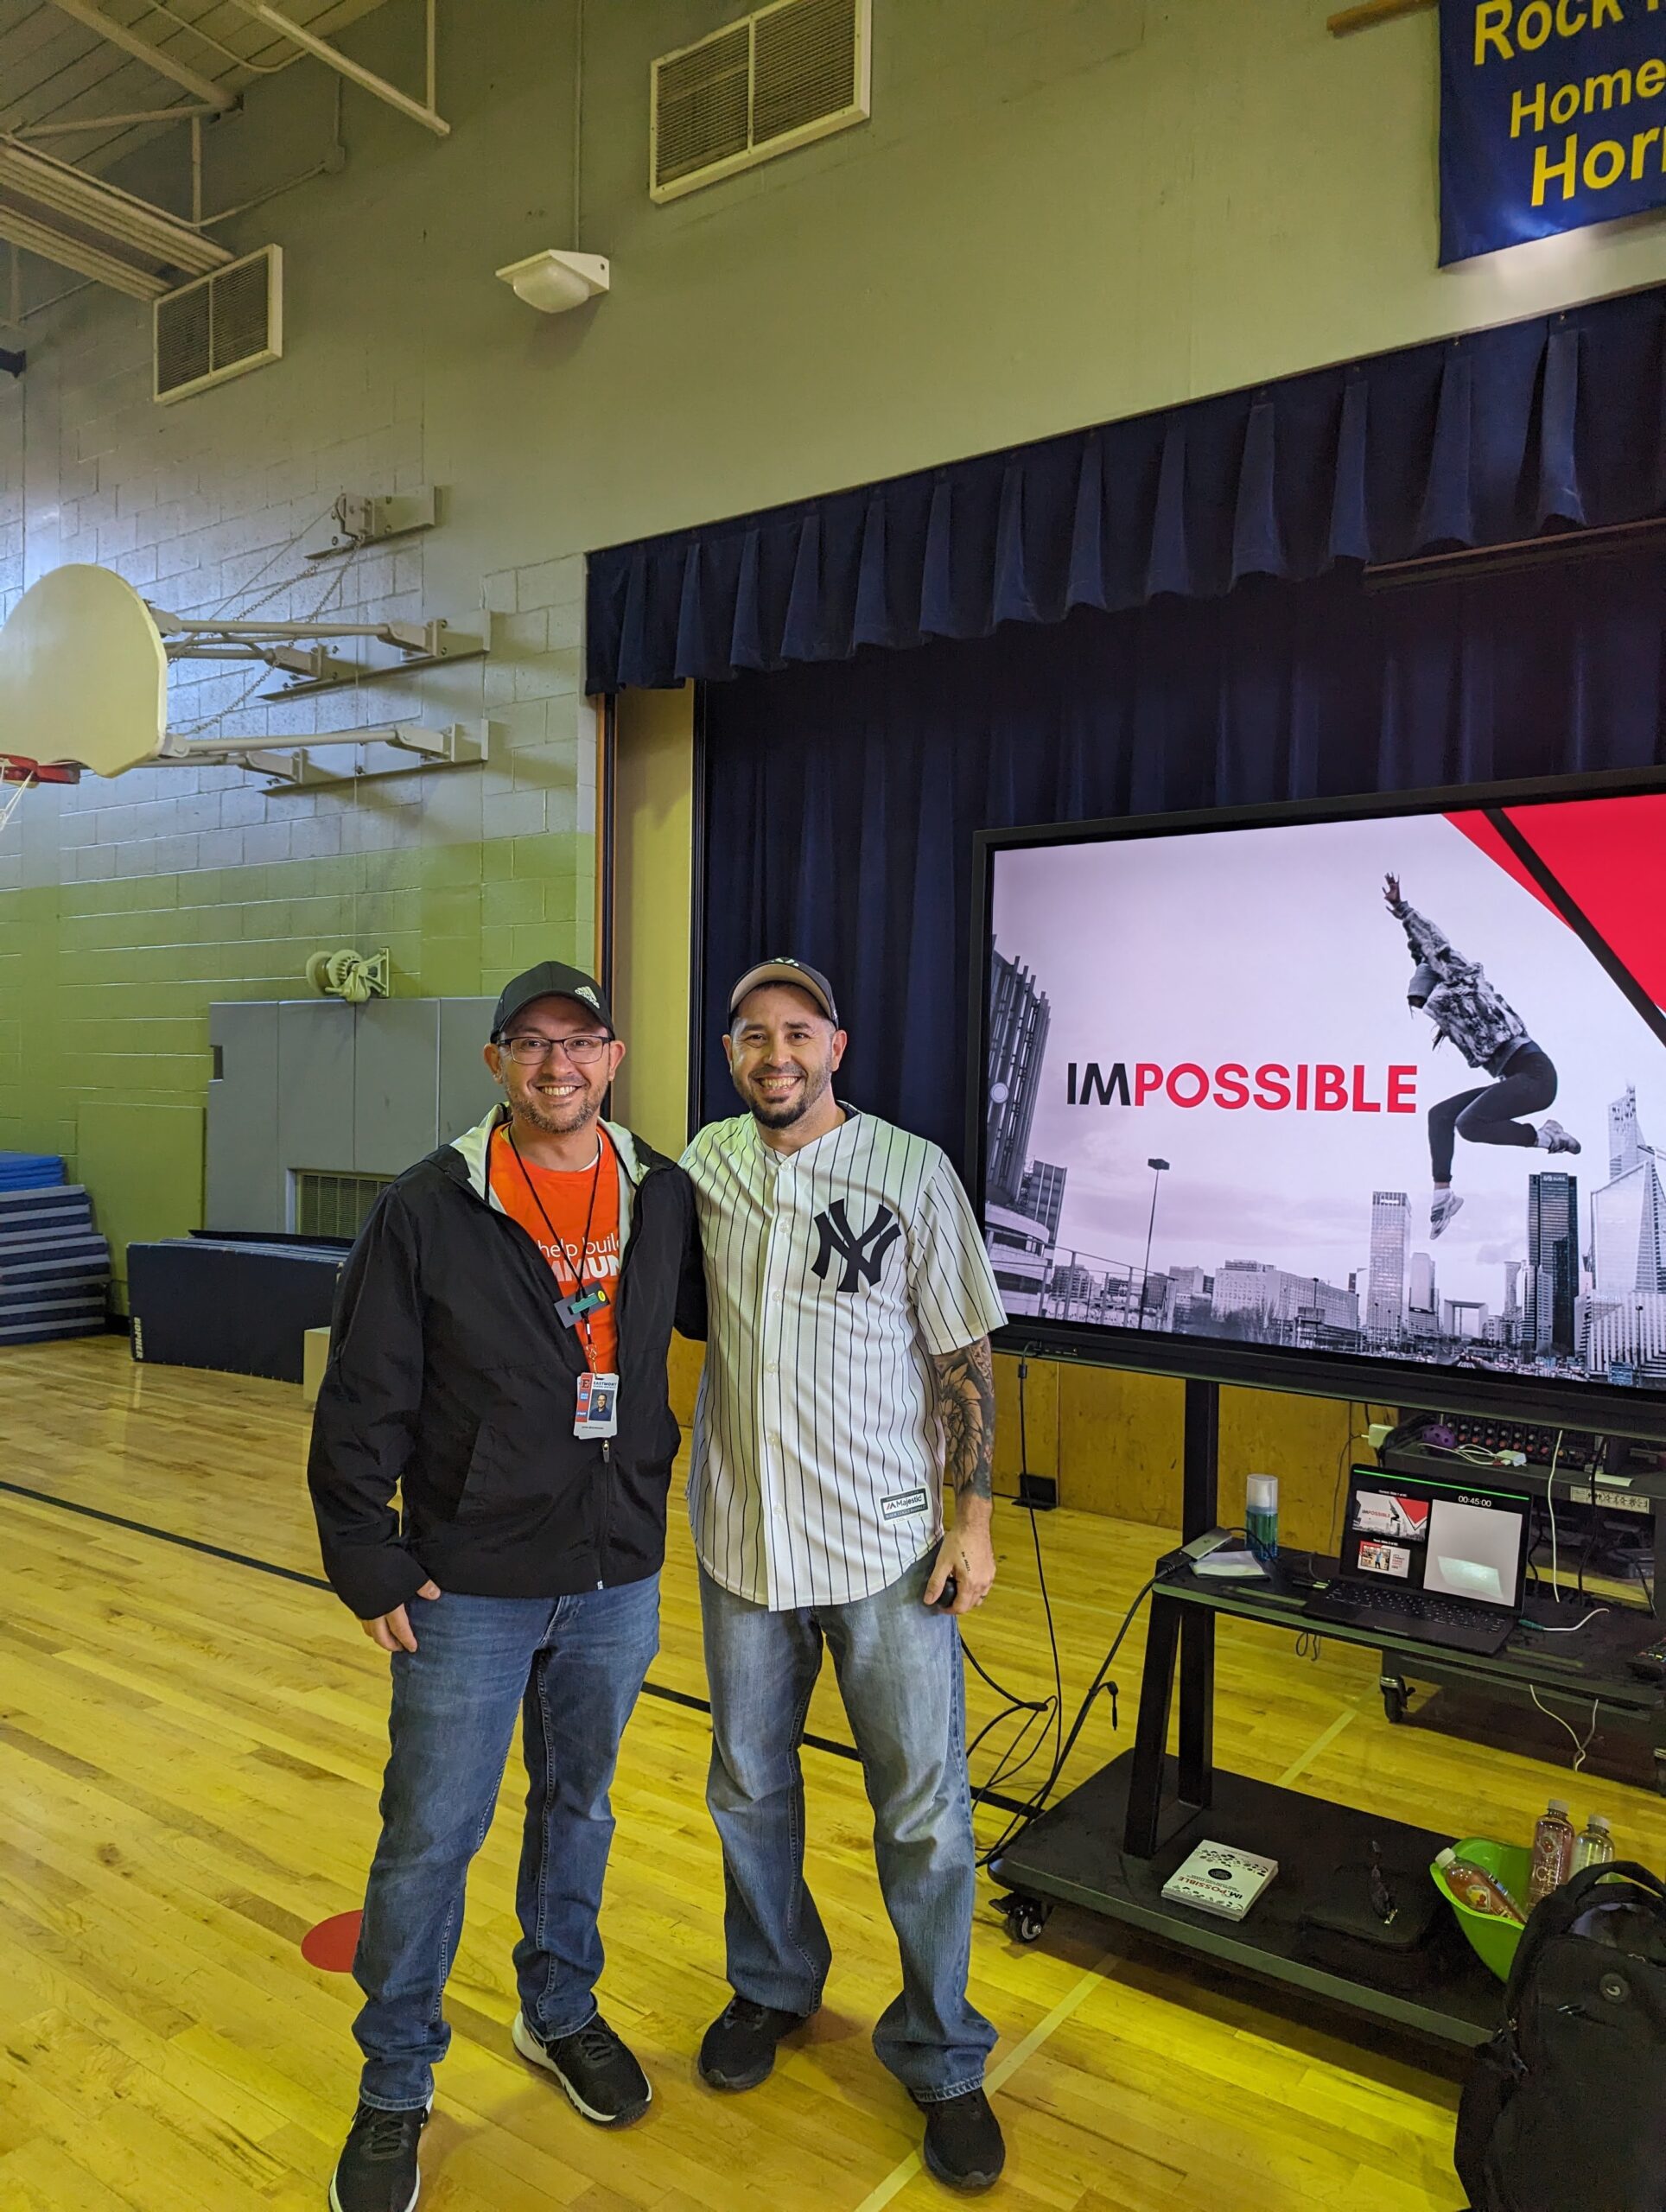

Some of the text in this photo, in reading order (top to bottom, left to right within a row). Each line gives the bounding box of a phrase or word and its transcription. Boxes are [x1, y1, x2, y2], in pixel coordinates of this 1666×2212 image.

[1510, 58, 1666, 138] Home
[1530, 126, 1666, 207] Hor
[1067, 1062, 1417, 1114] IMPOSSIBLE
[811, 1198, 902, 1293] NY
[134, 1316, 143, 1359] GOPHER
[896, 1495, 923, 1507] Majestic
[1458, 1495, 1492, 1508] 00:45:00
